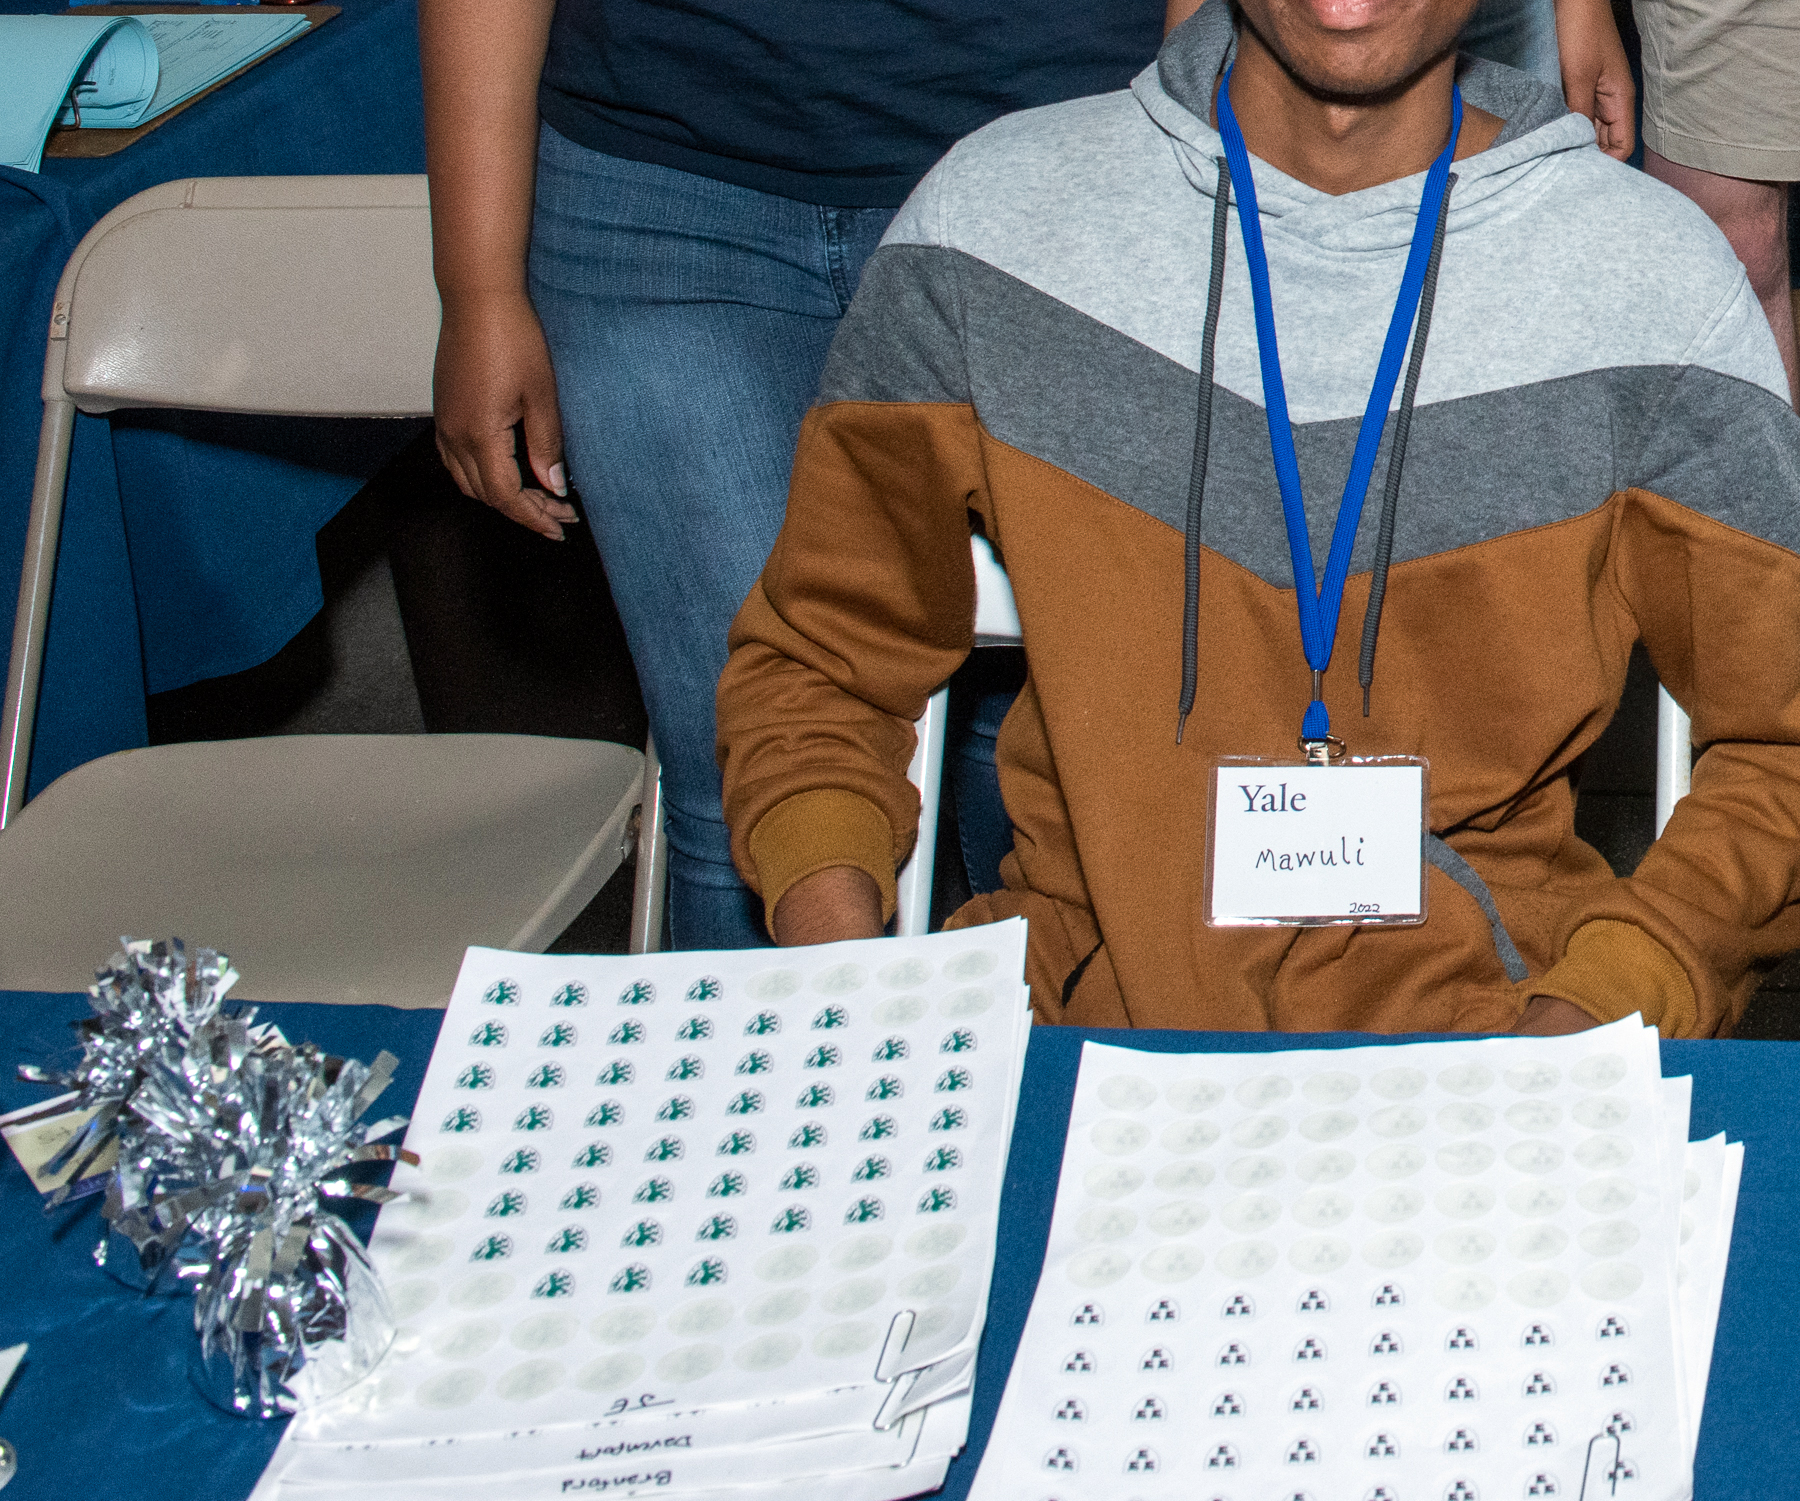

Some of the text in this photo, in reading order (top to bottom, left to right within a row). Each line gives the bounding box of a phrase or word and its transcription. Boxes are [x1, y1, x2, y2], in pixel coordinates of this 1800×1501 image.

[1238, 783, 1307, 812] Yale
[574, 1435, 692, 1462] Davenport
[561, 1470, 672, 1493] Branford
